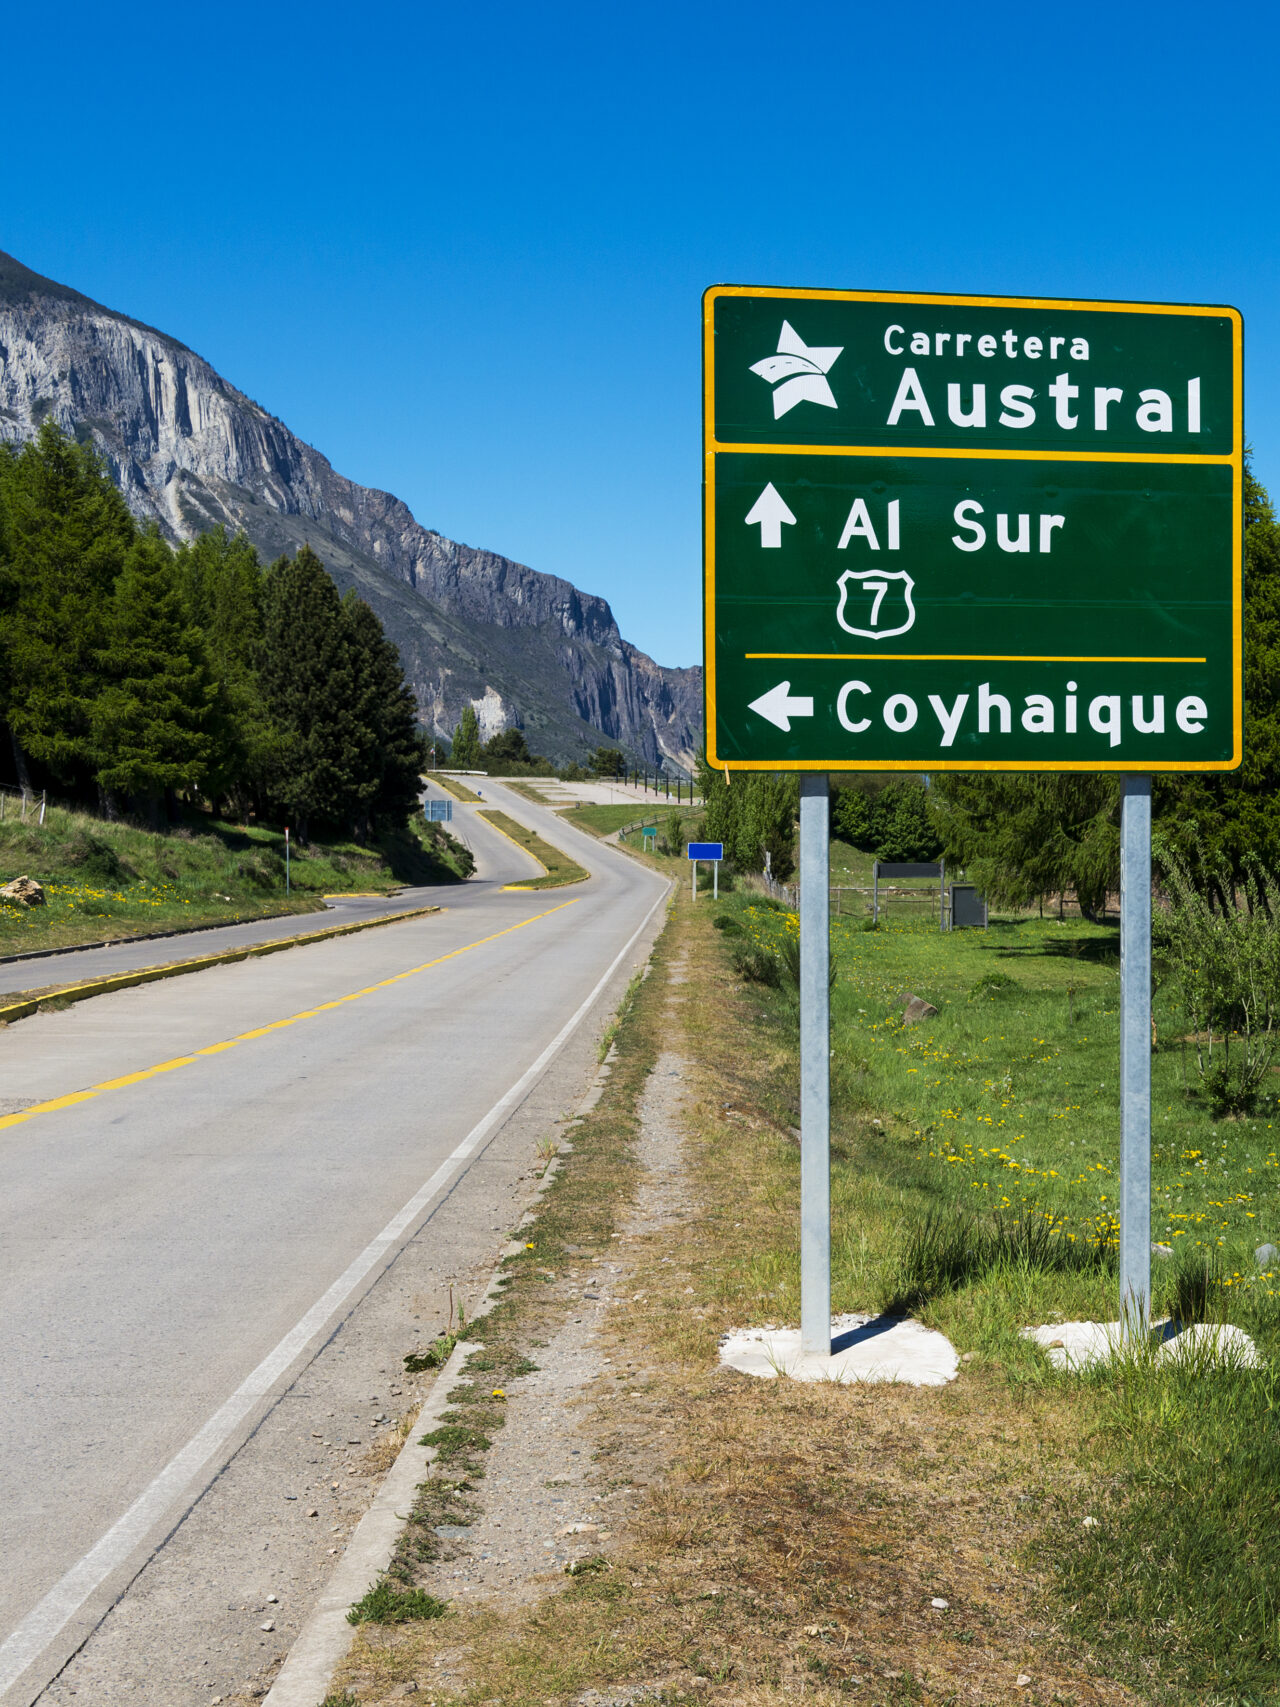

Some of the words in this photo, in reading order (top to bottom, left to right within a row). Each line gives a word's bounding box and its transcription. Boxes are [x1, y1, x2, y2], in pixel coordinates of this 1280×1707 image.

[884, 325, 1090, 360] Carretera
[887, 368, 1201, 432] Austral
[837, 498, 901, 550] Al
[952, 500, 1066, 553] Sur
[863, 582, 888, 625] 7
[836, 680, 1208, 747] Coyhaique
